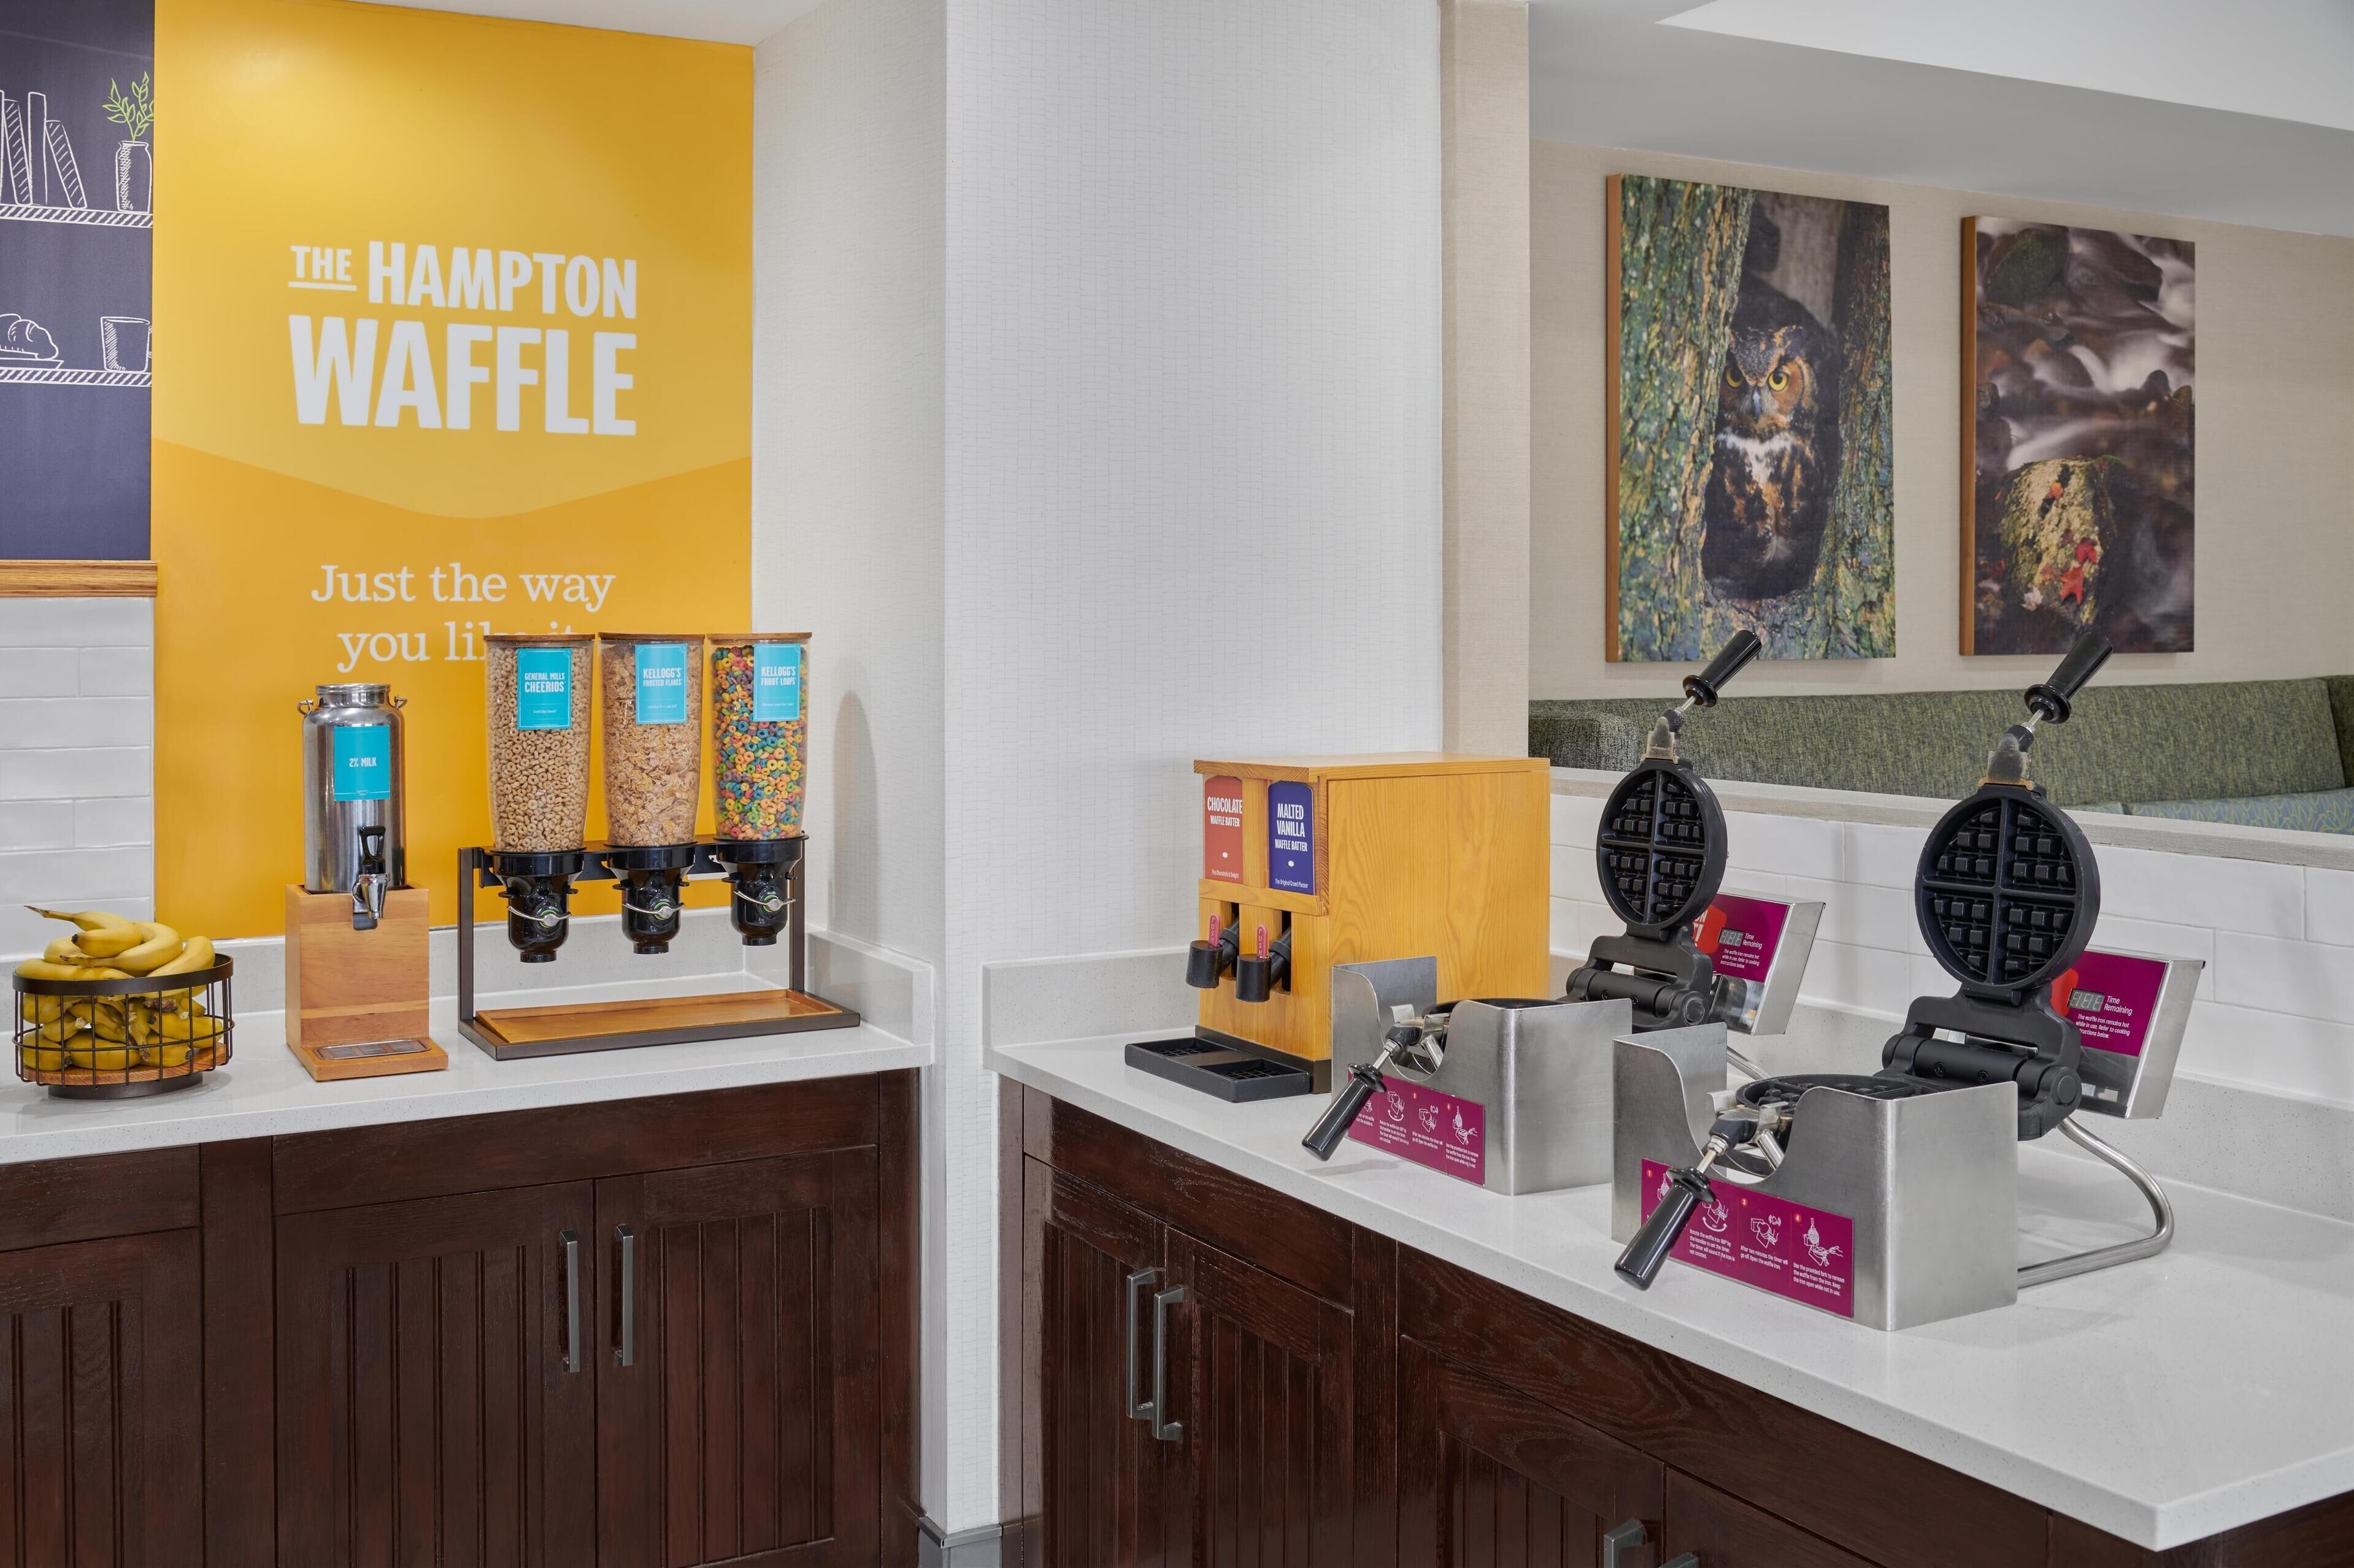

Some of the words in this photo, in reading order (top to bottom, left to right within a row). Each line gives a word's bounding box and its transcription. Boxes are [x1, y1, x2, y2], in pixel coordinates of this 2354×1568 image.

[290, 245, 352, 281] THE
[369, 240, 637, 318] HAMPTON
[288, 315, 637, 436] WAFFLE
[311, 564, 415, 602] Just
[429, 563, 507, 602] the
[519, 574, 616, 612] way
[337, 631, 431, 673] you
[444, 621, 526, 661] li
[643, 667, 682, 678] KELLOGG'S
[761, 666, 796, 677] KELLOGG'S
[525, 681, 564, 693] CHEERIOS
[761, 677, 779, 686] FROOT
[780, 677, 796, 685] LOOPS
[349, 758, 359, 767] 2%
[361, 757, 377, 767] MILK
[1207, 796, 1243, 814] CHOCOLATE
[1277, 803, 1304, 820] MALTED
[1210, 815, 1225, 826] WAFFLE
[1225, 817, 1240, 828] BATTER
[1276, 820, 1306, 837] VANILLA
[1274, 839, 1291, 850] WAFFLE
[1291, 840, 1308, 852] BATTER
[1742, 940, 1763, 950] Remaining
[2104, 1004, 2133, 1016] Remaining
[1806, 1267, 1820, 1275] provided
